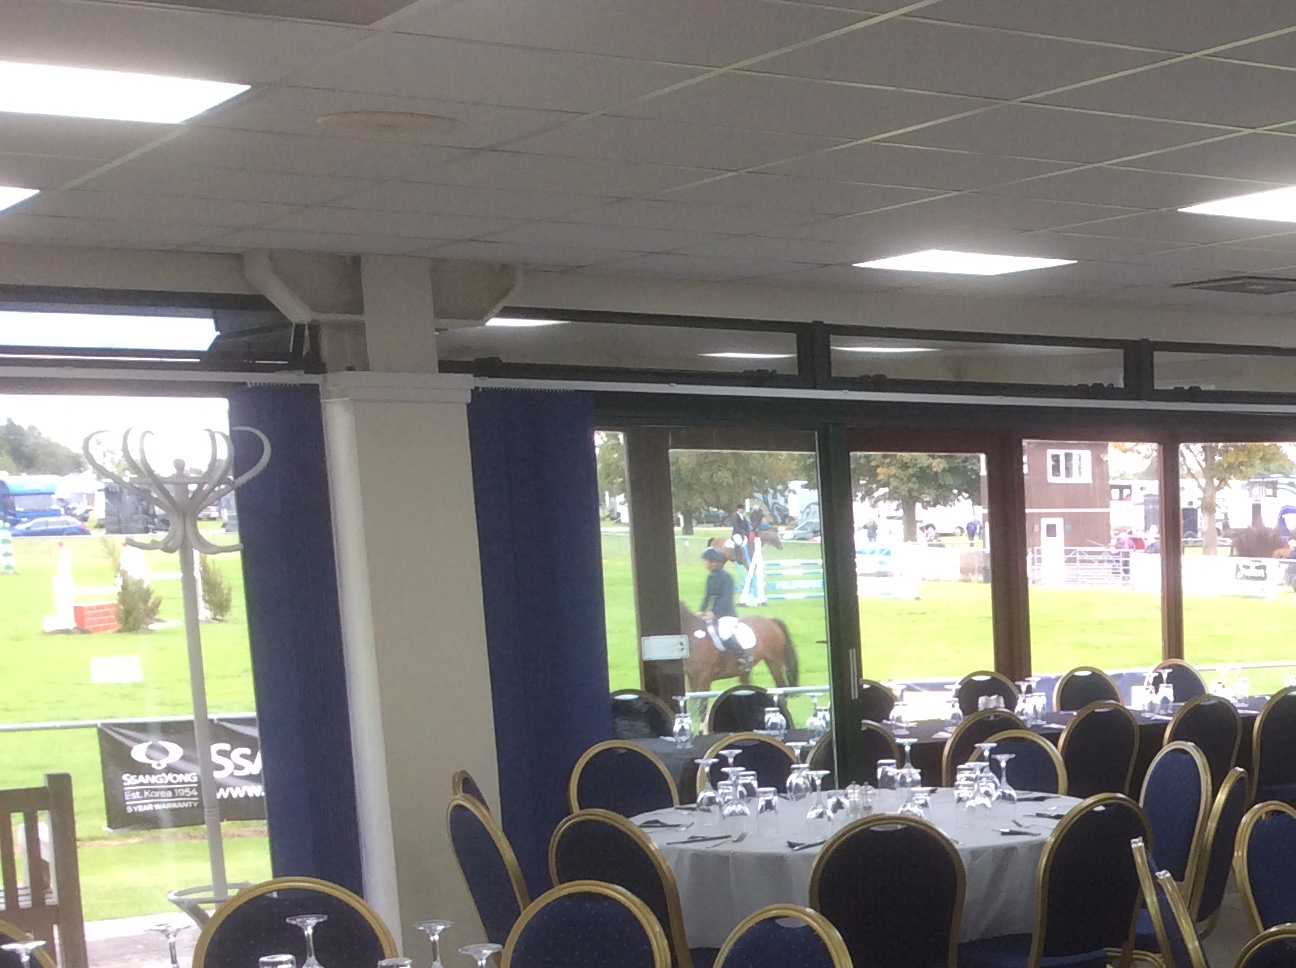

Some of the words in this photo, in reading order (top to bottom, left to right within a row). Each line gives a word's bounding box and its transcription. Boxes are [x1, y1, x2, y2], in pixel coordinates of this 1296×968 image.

[124, 790, 143, 800] Est.
[144, 789, 173, 798] Korea
[133, 803, 154, 812] YEAR
[154, 801, 199, 810] WARRANTY
